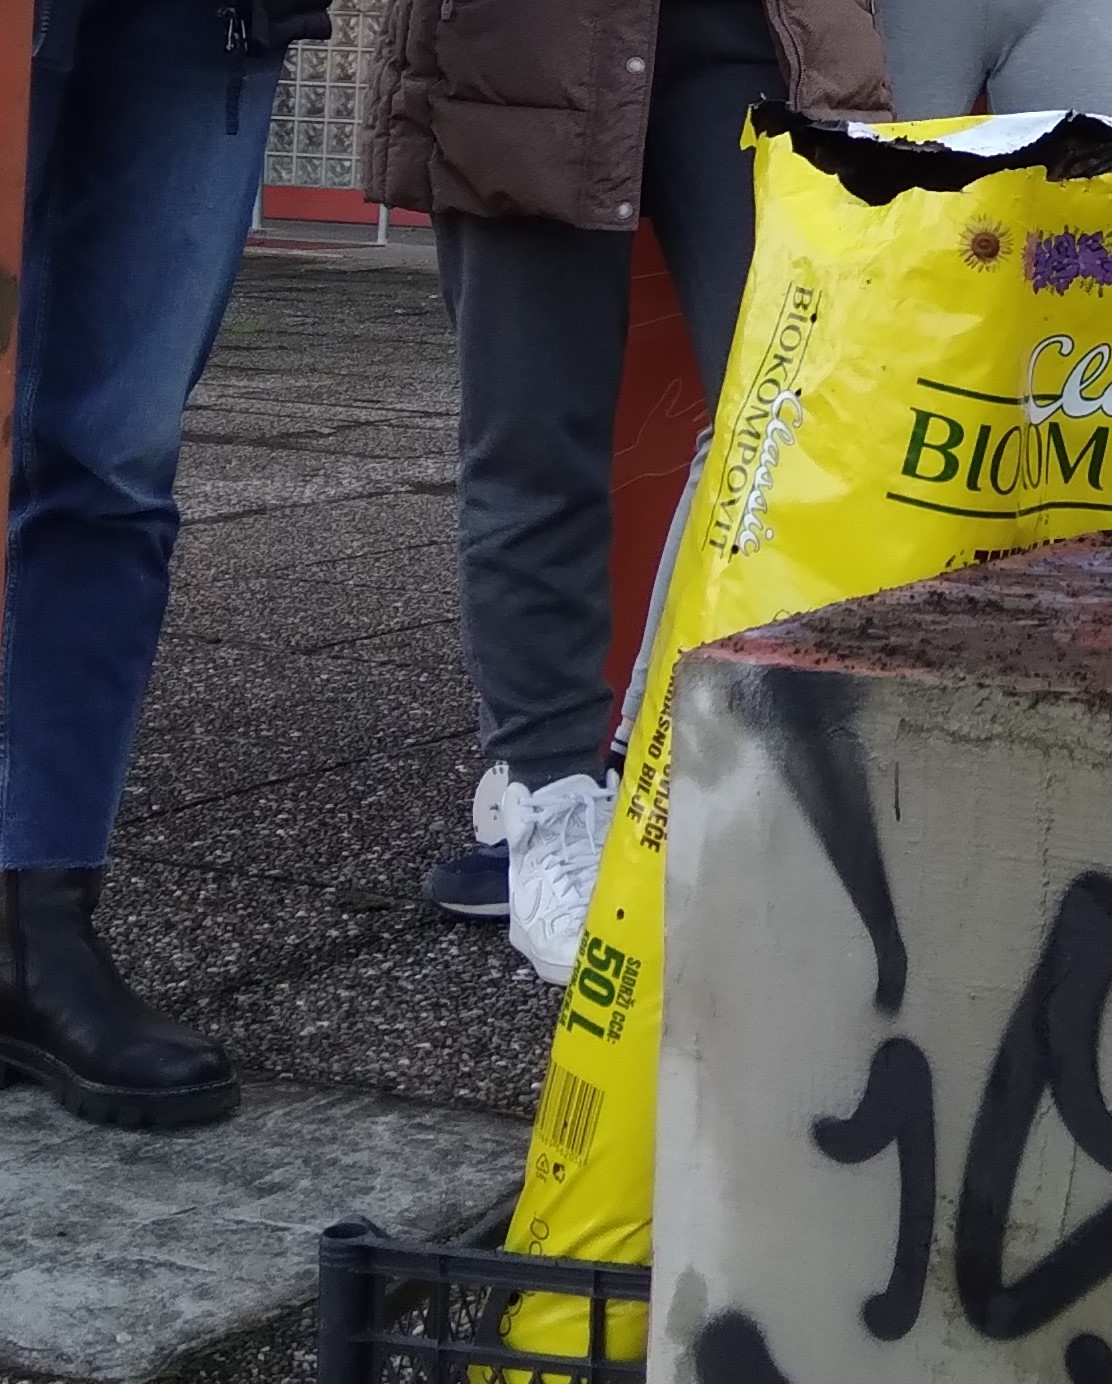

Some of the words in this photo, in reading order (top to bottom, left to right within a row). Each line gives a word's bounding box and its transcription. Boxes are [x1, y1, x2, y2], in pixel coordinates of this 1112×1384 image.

[709, 285, 814, 559] BIOKOMPOVIT
[738, 389, 803, 557] Classic
[627, 763, 657, 822] BILJE
[578, 936, 625, 1008] 50
[620, 956, 641, 1011] SADRŽI
